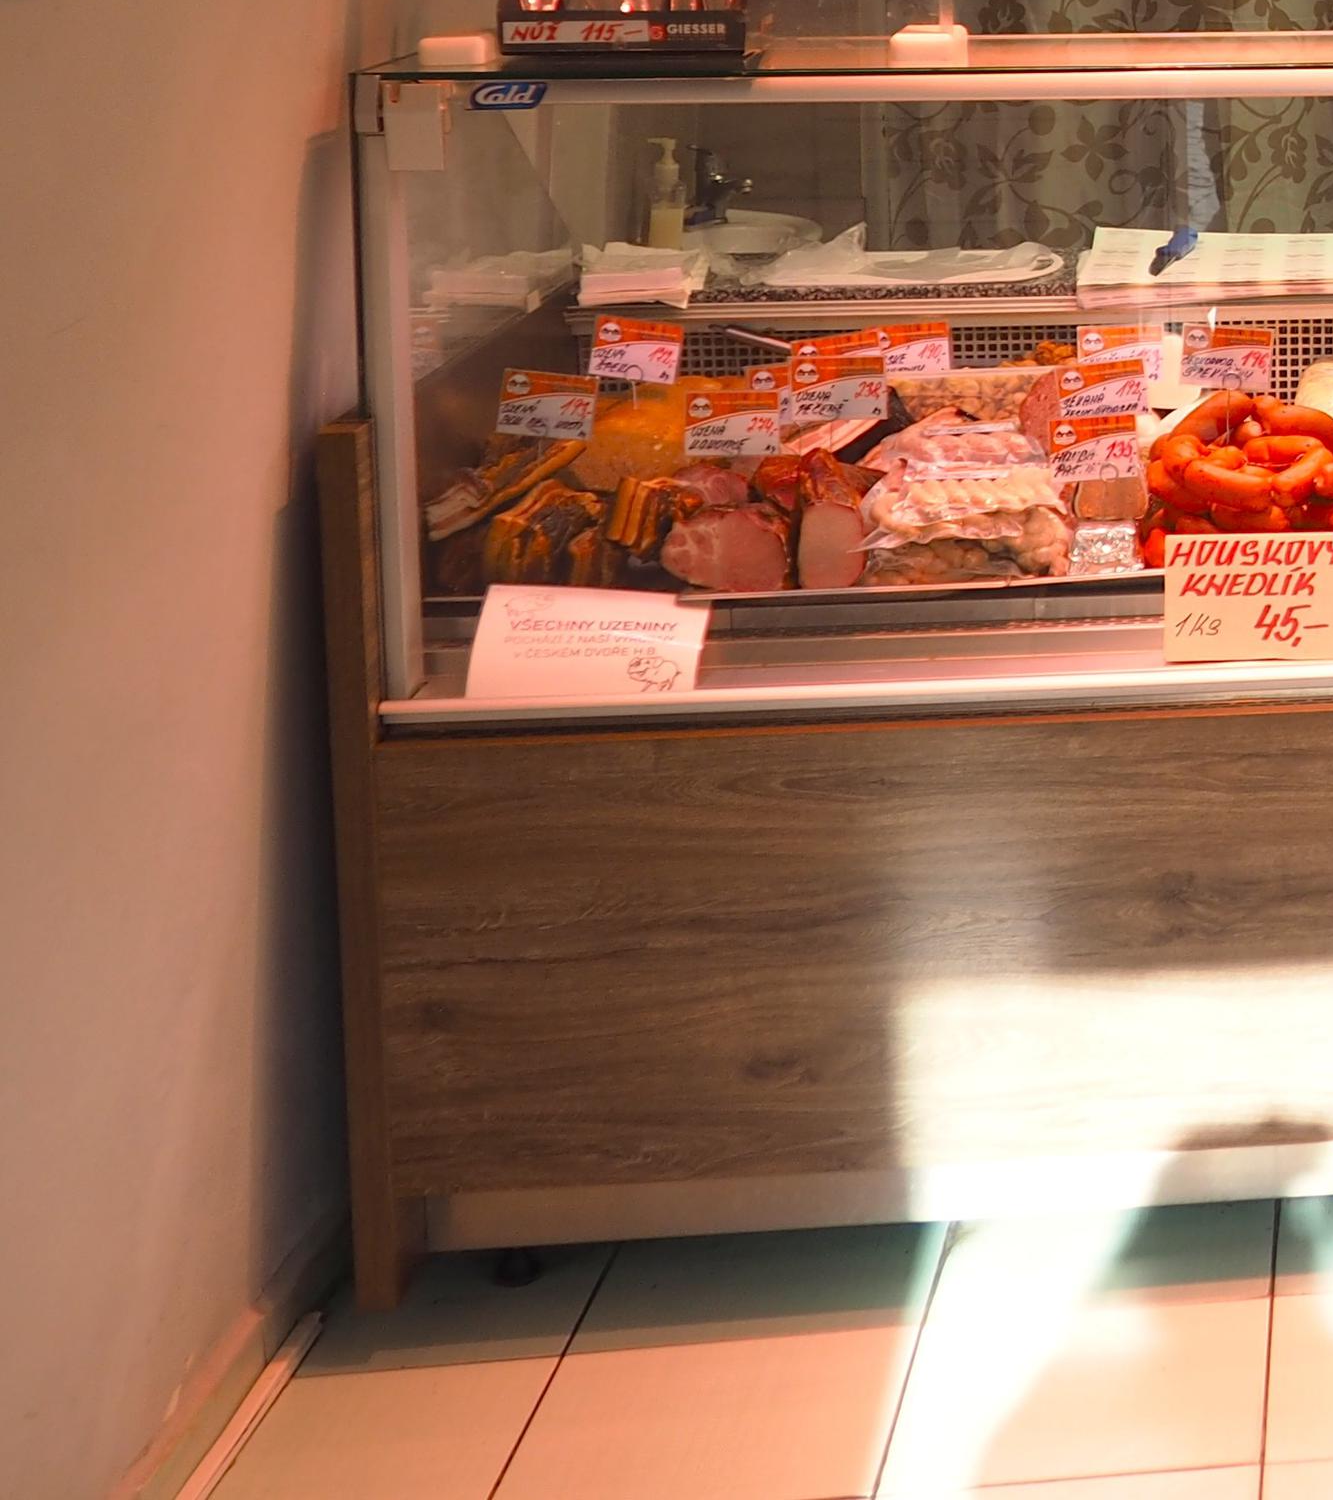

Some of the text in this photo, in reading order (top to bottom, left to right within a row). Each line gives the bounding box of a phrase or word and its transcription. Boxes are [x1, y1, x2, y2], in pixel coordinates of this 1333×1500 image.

[666, 23, 727, 35] GIESSER
[1179, 566, 1317, 597] KNEDLÍK
[510, 617, 679, 632] VŠECHNY UZENINY
